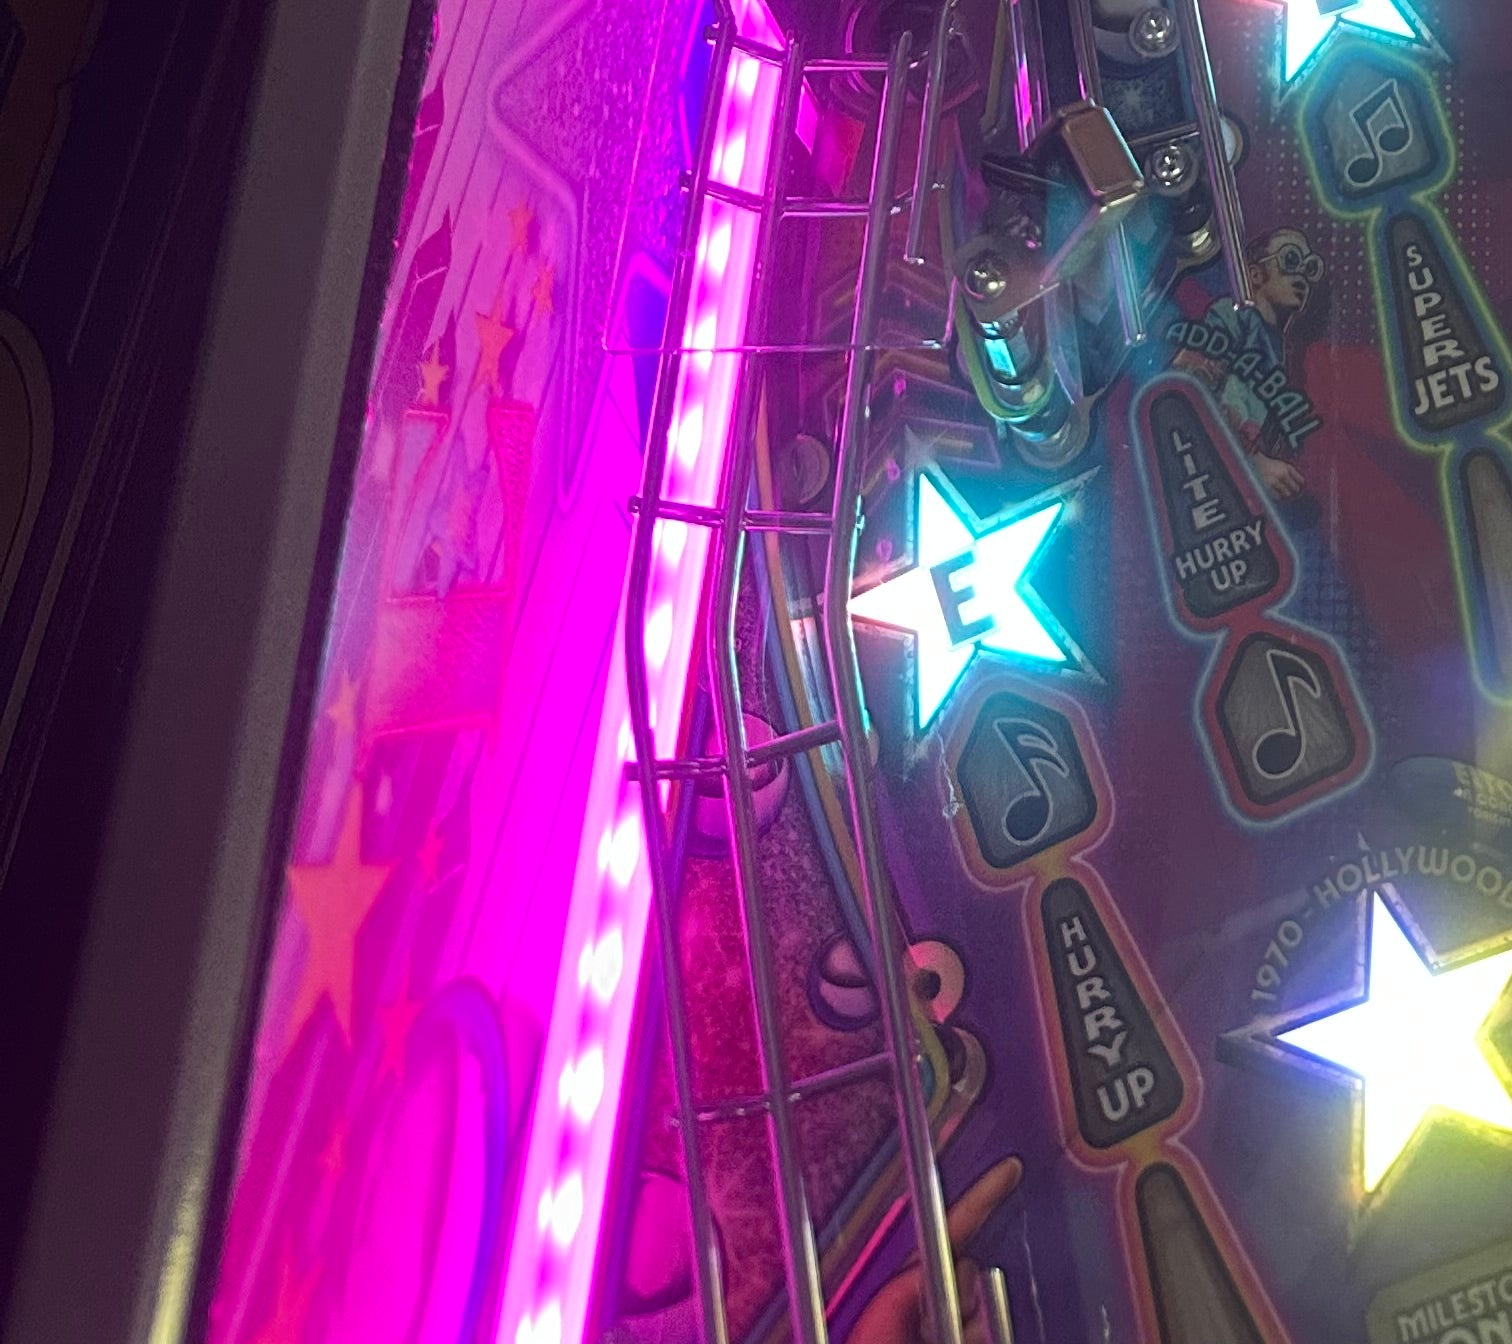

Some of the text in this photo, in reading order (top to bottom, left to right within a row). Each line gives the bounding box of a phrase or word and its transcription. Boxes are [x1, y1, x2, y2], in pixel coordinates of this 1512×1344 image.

[1405, 244, 1465, 368] SUPER
[1165, 321, 1321, 449] ADD-A-BALL
[1413, 355, 1500, 416] JETS
[1171, 430, 1227, 531] LITE
[1175, 519, 1263, 580] HURRY
[1209, 559, 1249, 591] UP
[928, 549, 998, 647] E
[1059, 915, 1129, 1067] HURRY
[1250, 919, 1304, 1002] 1970
[1096, 1066, 1155, 1122] UP
